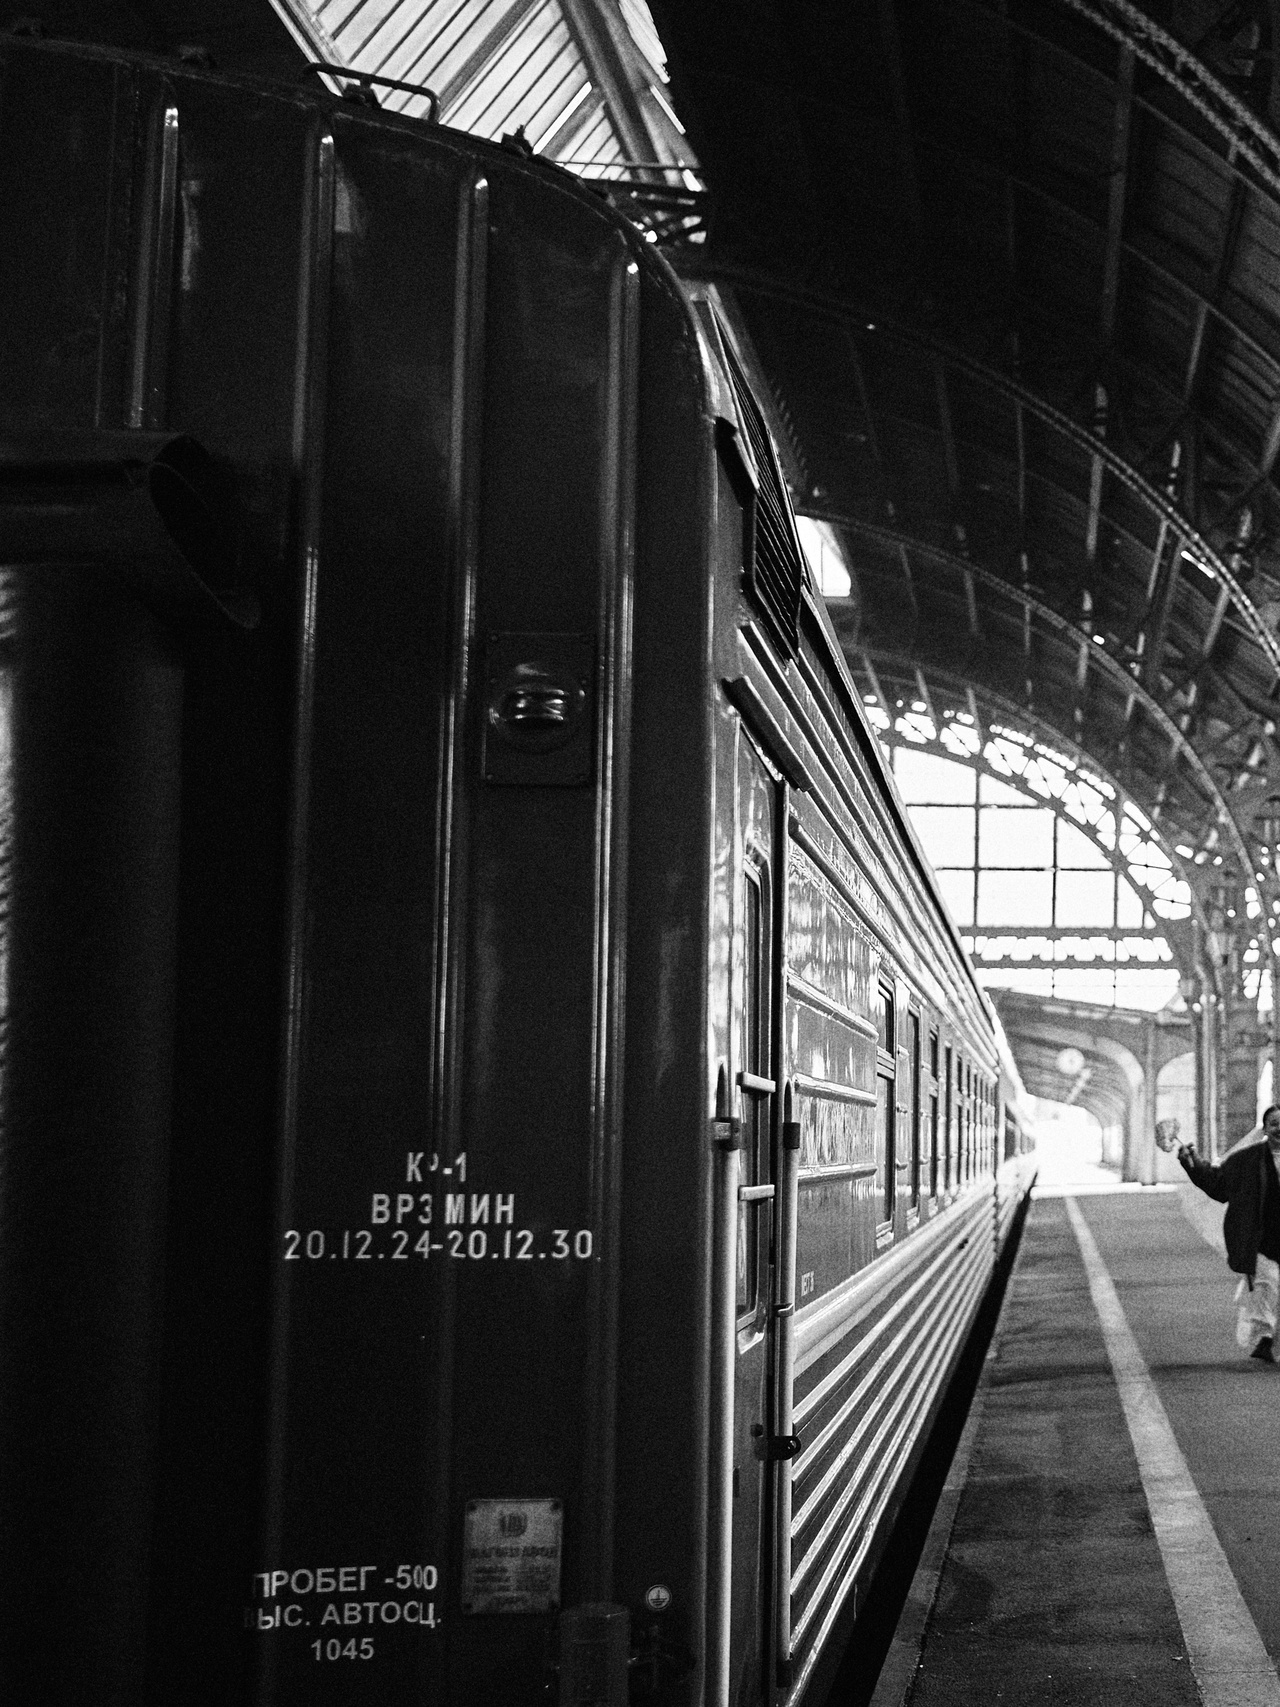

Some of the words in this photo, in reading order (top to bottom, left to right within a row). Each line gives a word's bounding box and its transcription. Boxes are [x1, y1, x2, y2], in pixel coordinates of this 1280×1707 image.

[371, 1193, 433, 1225] ВРЗ
[443, 1193, 515, 1226] МИН
[384, 1564, 439, 1592] -500
[244, 1603, 310, 1630] ЫС.
[320, 1600, 443, 1629] АВТОСЦ.
[311, 1637, 375, 1661] 1045
